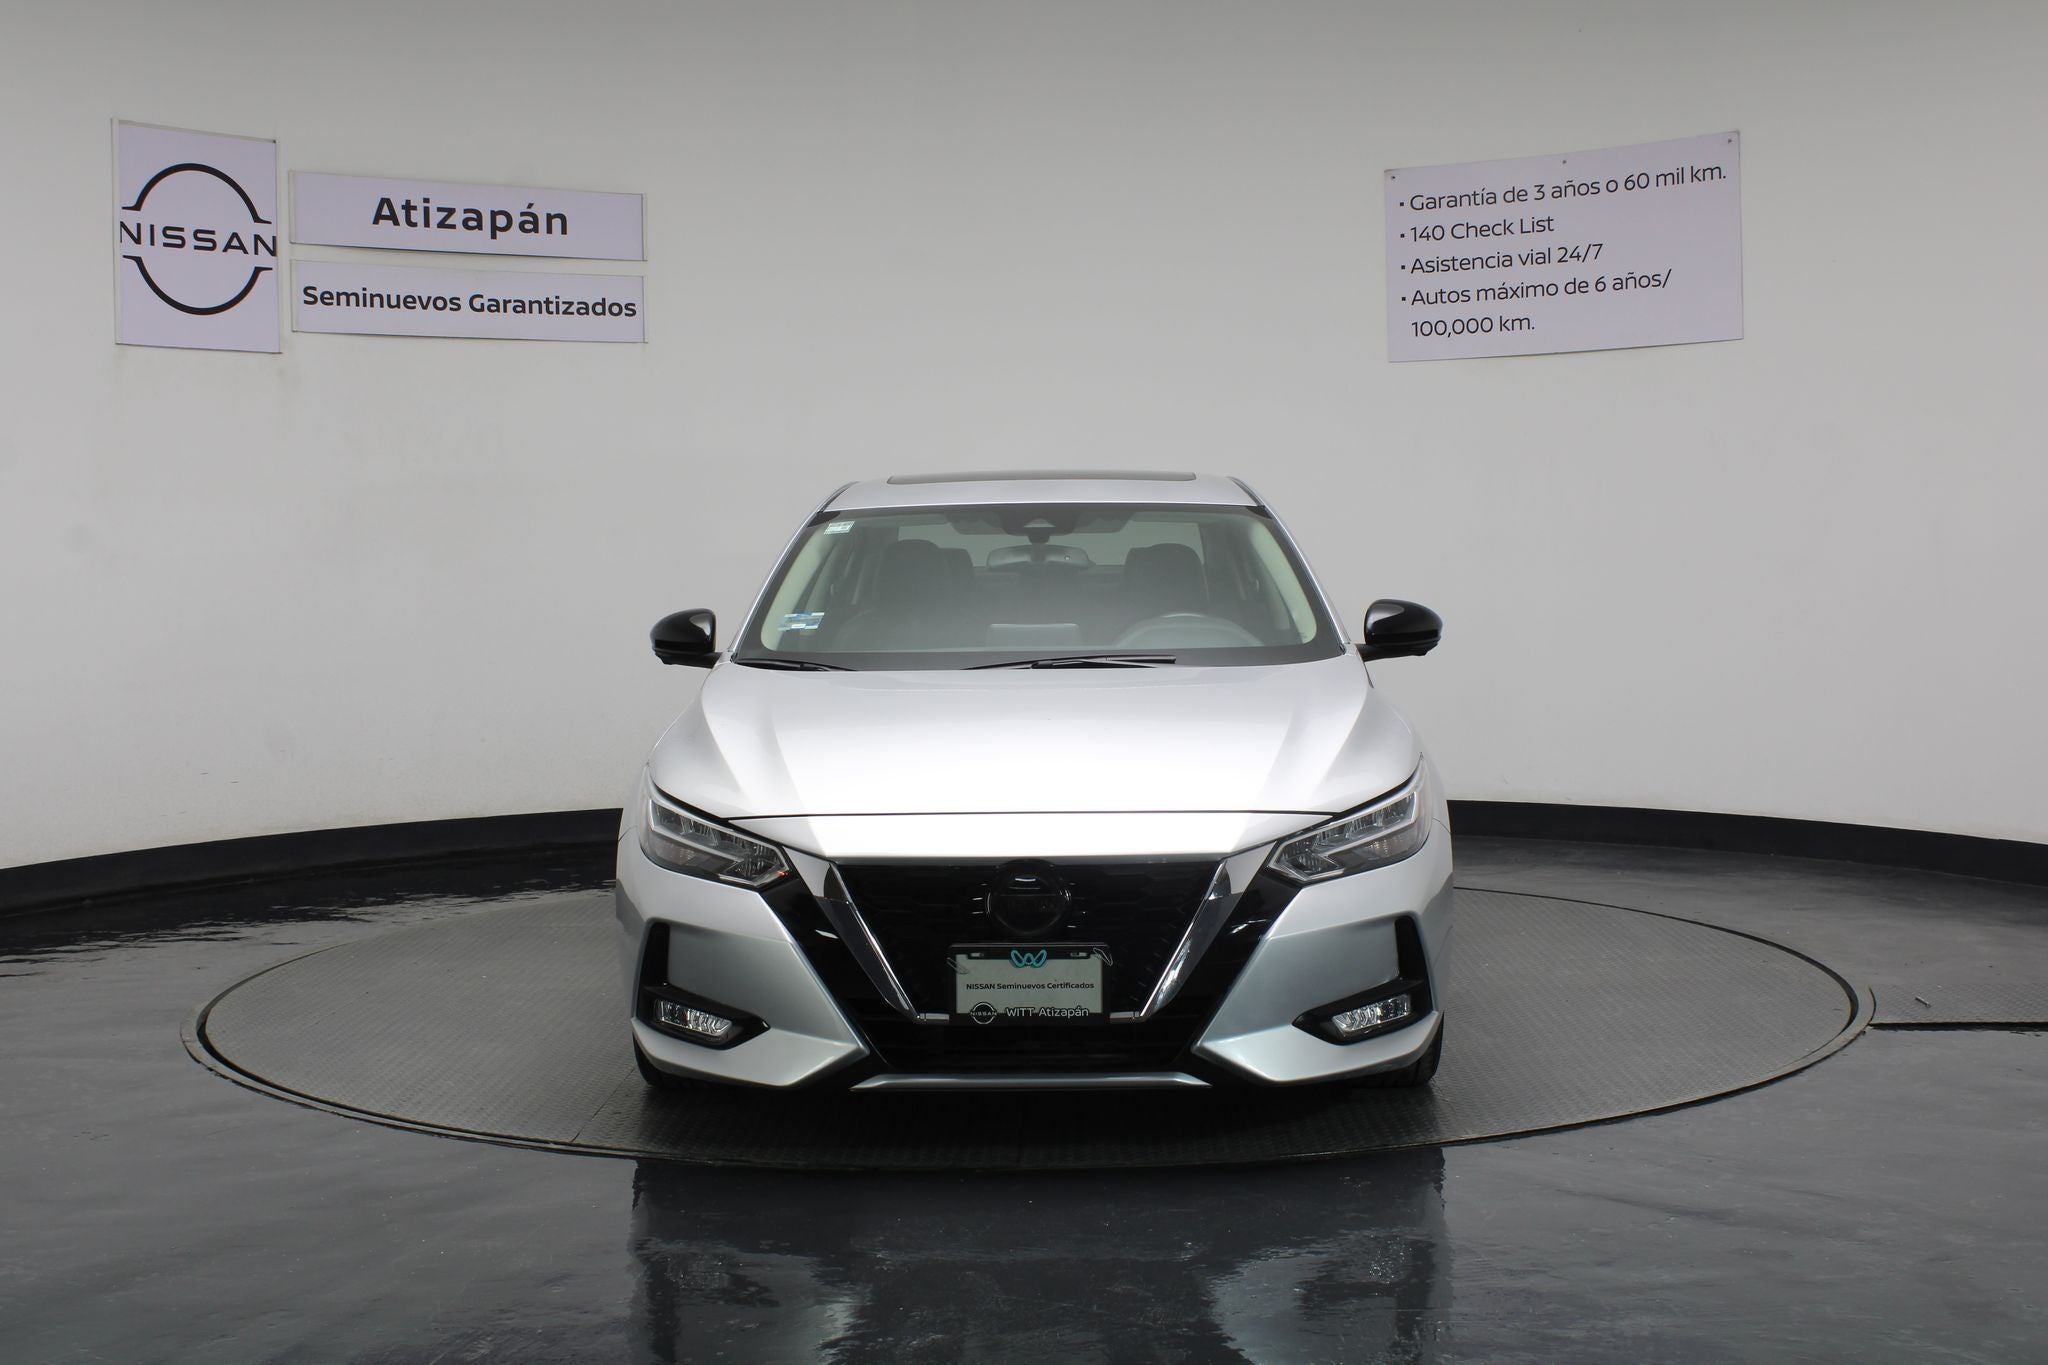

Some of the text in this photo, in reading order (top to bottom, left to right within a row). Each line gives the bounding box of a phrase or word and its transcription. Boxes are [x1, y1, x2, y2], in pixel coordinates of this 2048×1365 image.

[1409, 164, 1726, 211] Garantía de 3 años o 60 mil km.
[372, 197, 569, 240] Atizapán
[1410, 215, 1555, 242] 140 Check List
[119, 220, 277, 258] NISSAN
[1410, 243, 1603, 274] Asistencia vial 24/7
[302, 285, 637, 318] Seminuevos Garantizados
[1411, 269, 1672, 306] Autos máximo de 6 años/
[1411, 315, 1535, 338] 100,000 km.
[1046, 982, 1095, 990] Certificados
[1005, 1005, 1089, 1019] WITT Atizapán
